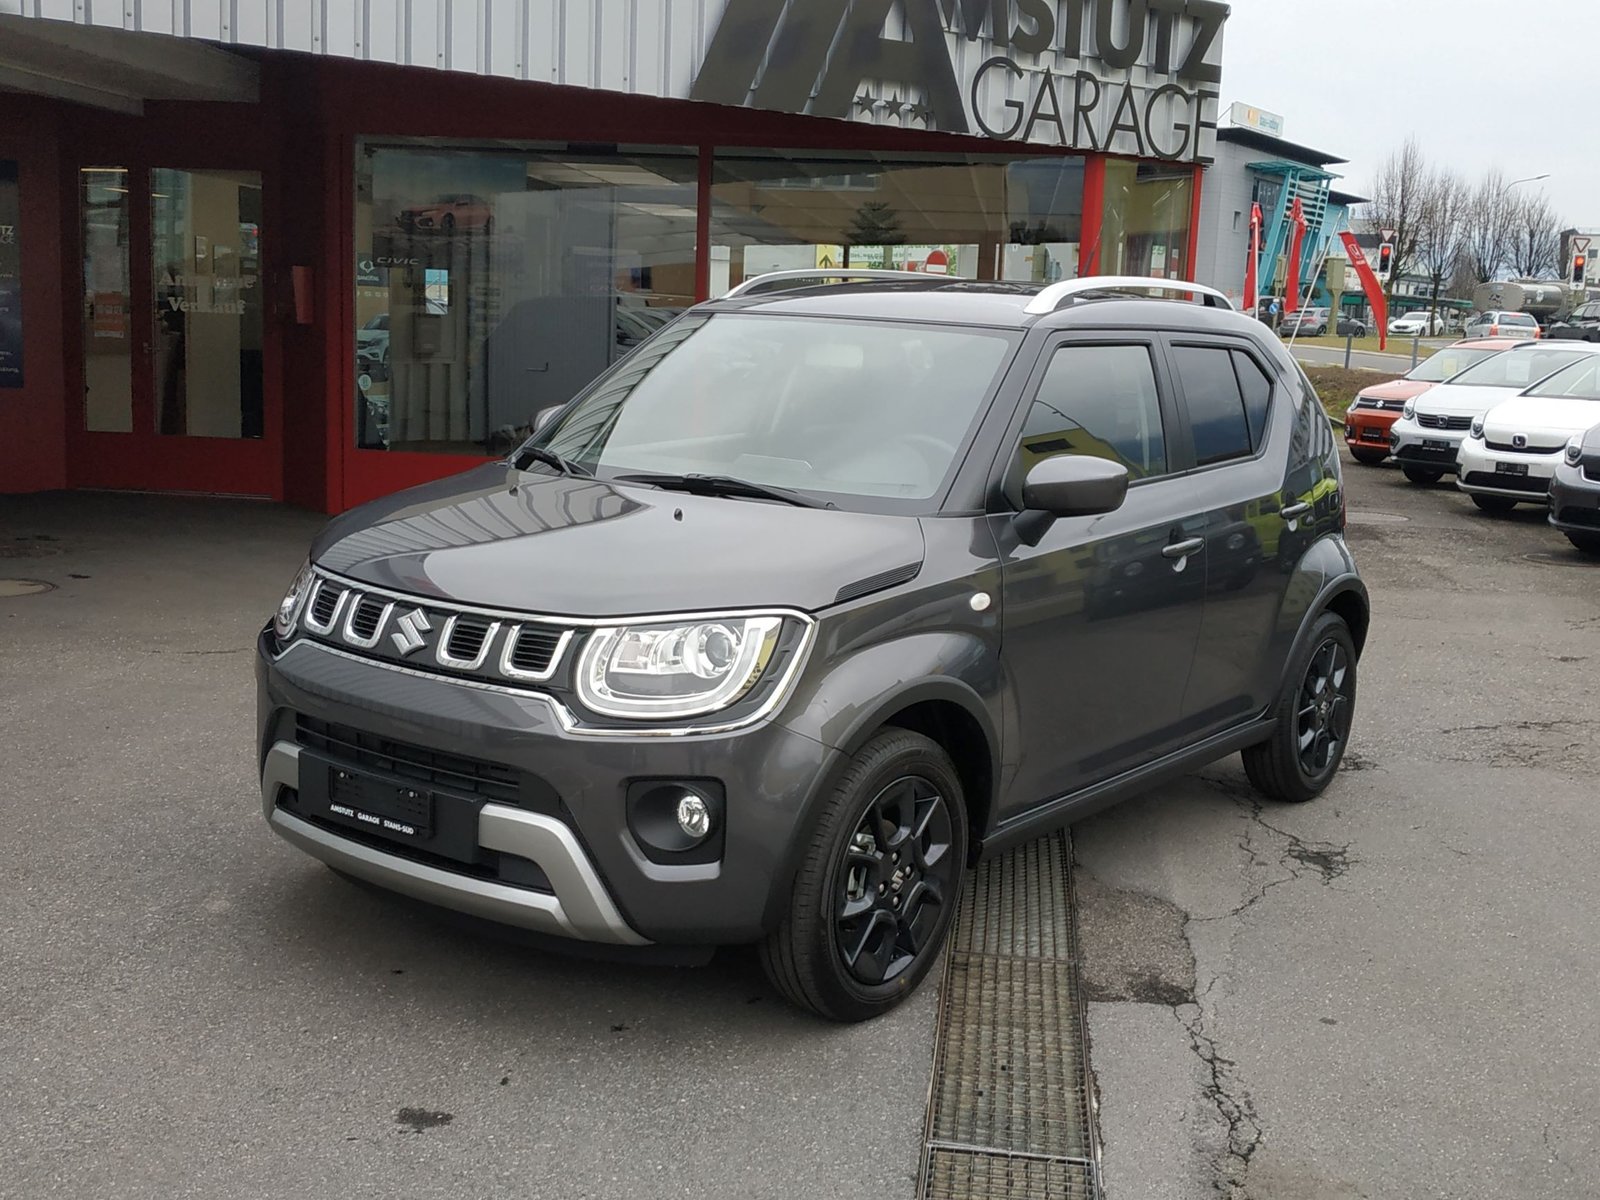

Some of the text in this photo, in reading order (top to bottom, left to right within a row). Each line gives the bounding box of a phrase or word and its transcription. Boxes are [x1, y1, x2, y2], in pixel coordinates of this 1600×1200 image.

[971, 56, 1220, 165] GARAGE
[377, 256, 419, 265] CIVIC
[357, 812, 380, 825] GARAGE
